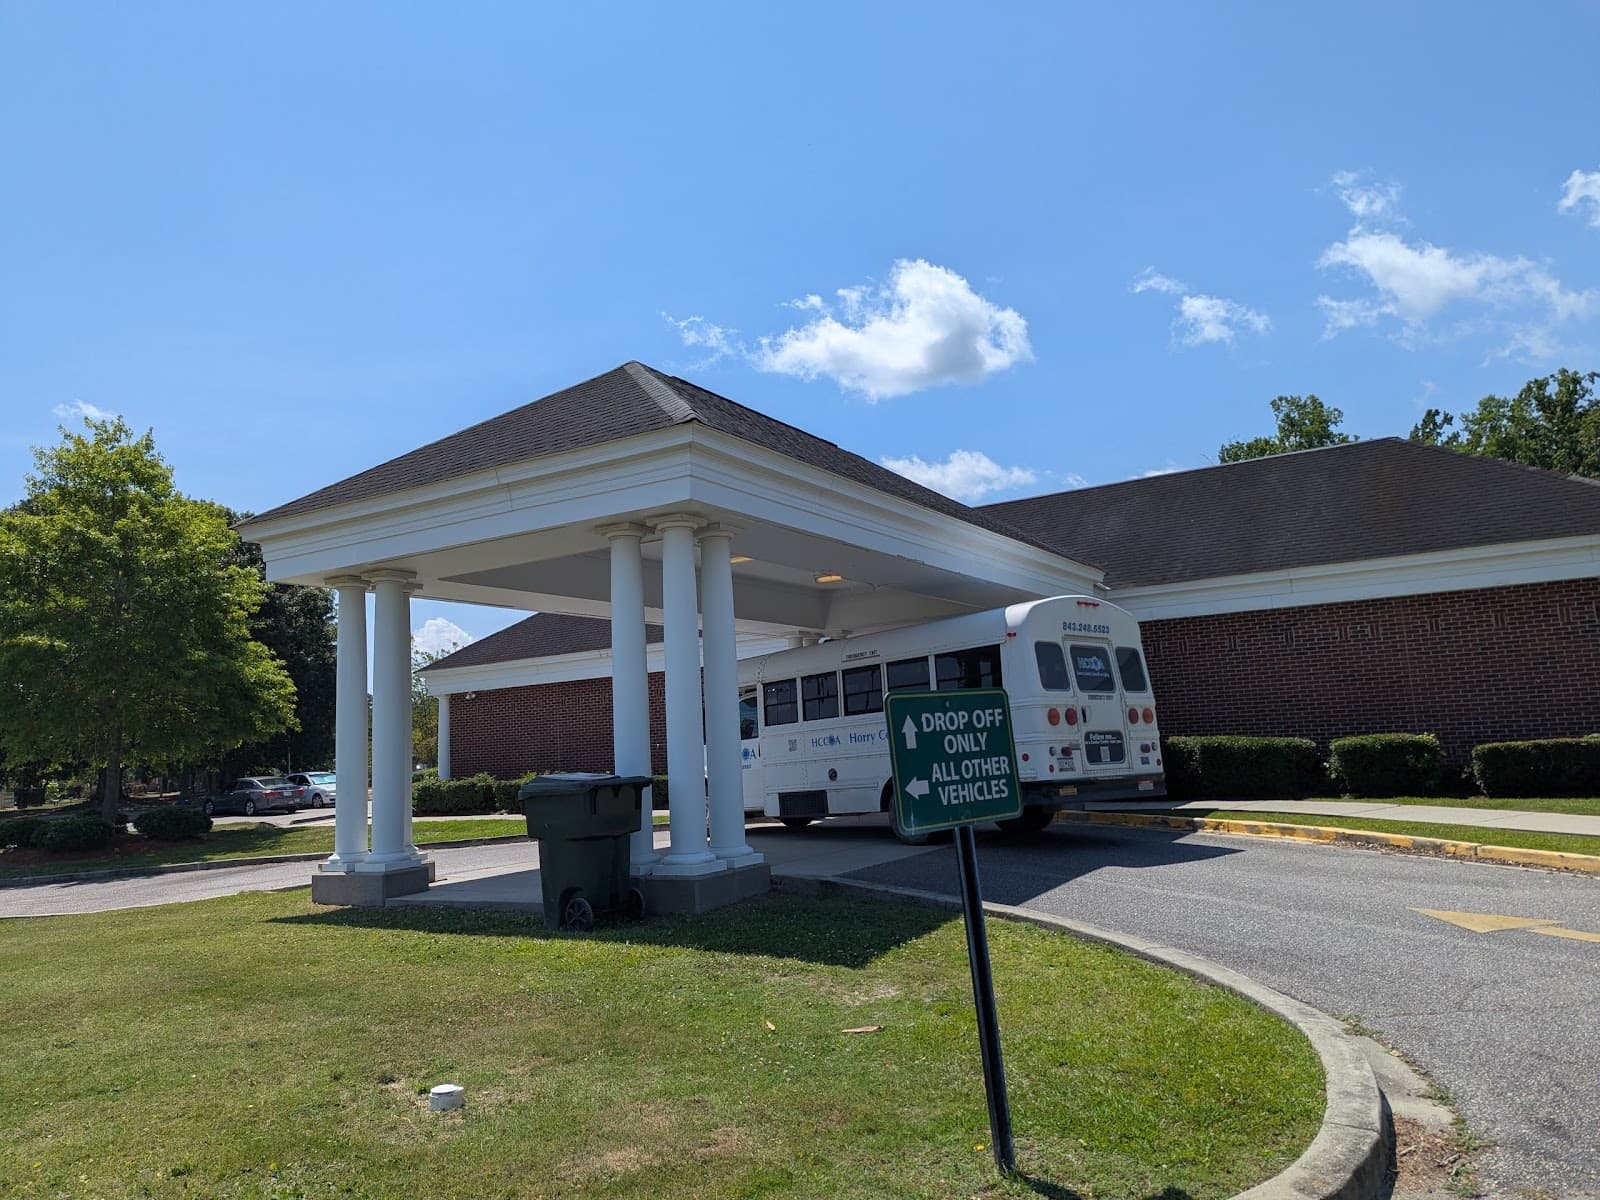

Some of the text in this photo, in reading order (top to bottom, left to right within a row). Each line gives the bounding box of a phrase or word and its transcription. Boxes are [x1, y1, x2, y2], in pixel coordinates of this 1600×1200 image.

[1062, 621, 1110, 634] 843.248.5523
[921, 708, 1004, 732] DROP OFF
[944, 732, 988, 754] ONLY
[932, 756, 1011, 783] ALL OTHER
[938, 779, 1009, 806] VEHICLES
